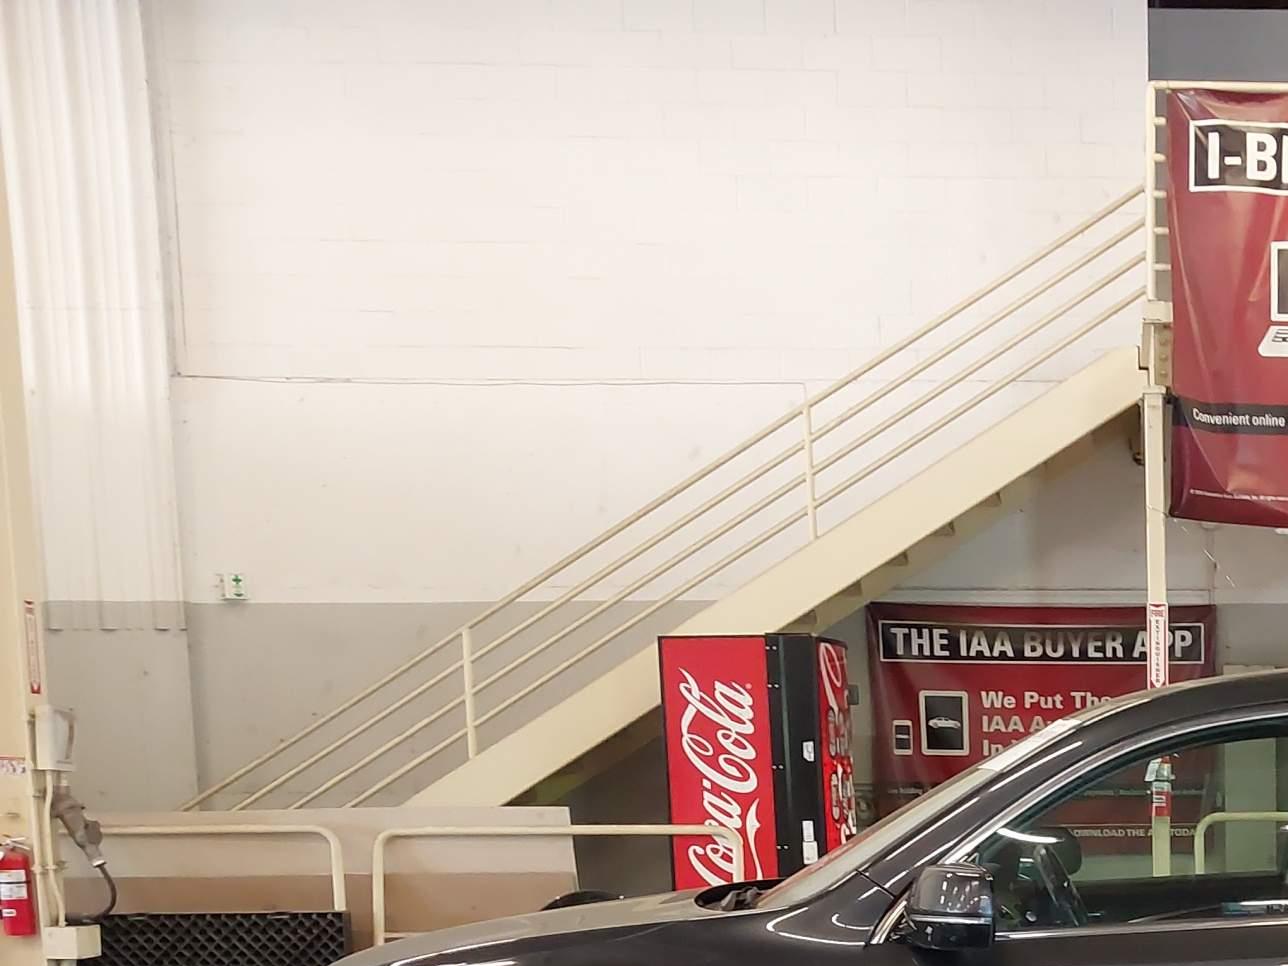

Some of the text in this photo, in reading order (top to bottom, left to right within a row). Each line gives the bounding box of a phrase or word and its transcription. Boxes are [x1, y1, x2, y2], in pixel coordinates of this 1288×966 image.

[1193, 407, 1250, 426] Convenient
[1252, 414, 1285, 427] online
[890, 627, 1193, 658] THE IAA BUYER AP
[980, 691, 1017, 709] We
[1023, 691, 1064, 709] Put
[982, 716, 1025, 732] IAA
[1126, 828, 1146, 837] THE
